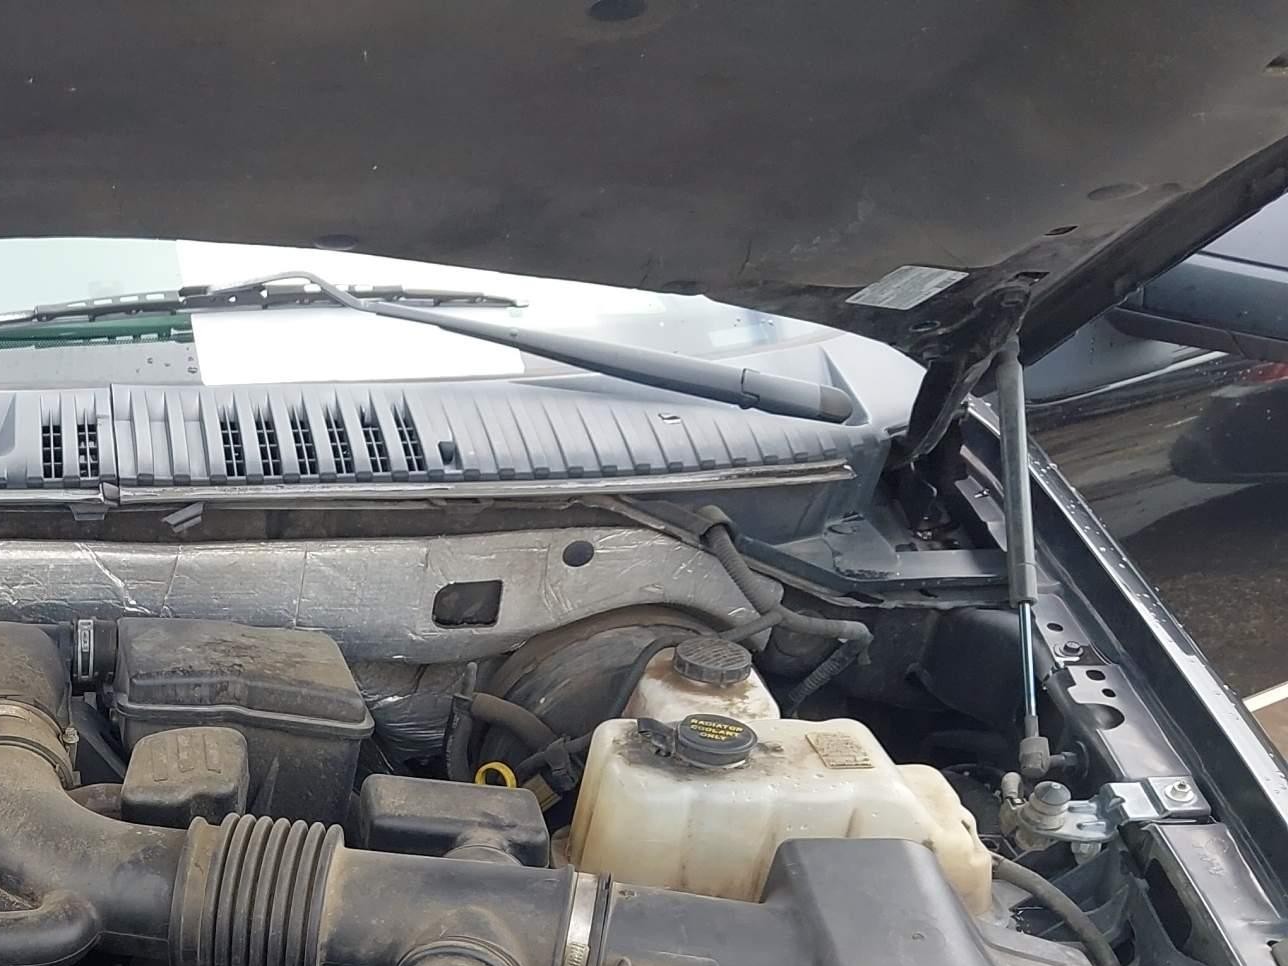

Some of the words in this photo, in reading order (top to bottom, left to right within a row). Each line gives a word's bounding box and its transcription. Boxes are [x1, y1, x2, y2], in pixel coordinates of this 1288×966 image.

[690, 718, 744, 732] RADIATOR
[690, 724, 740, 737] COOLANT
[699, 731, 726, 741] ONLY
